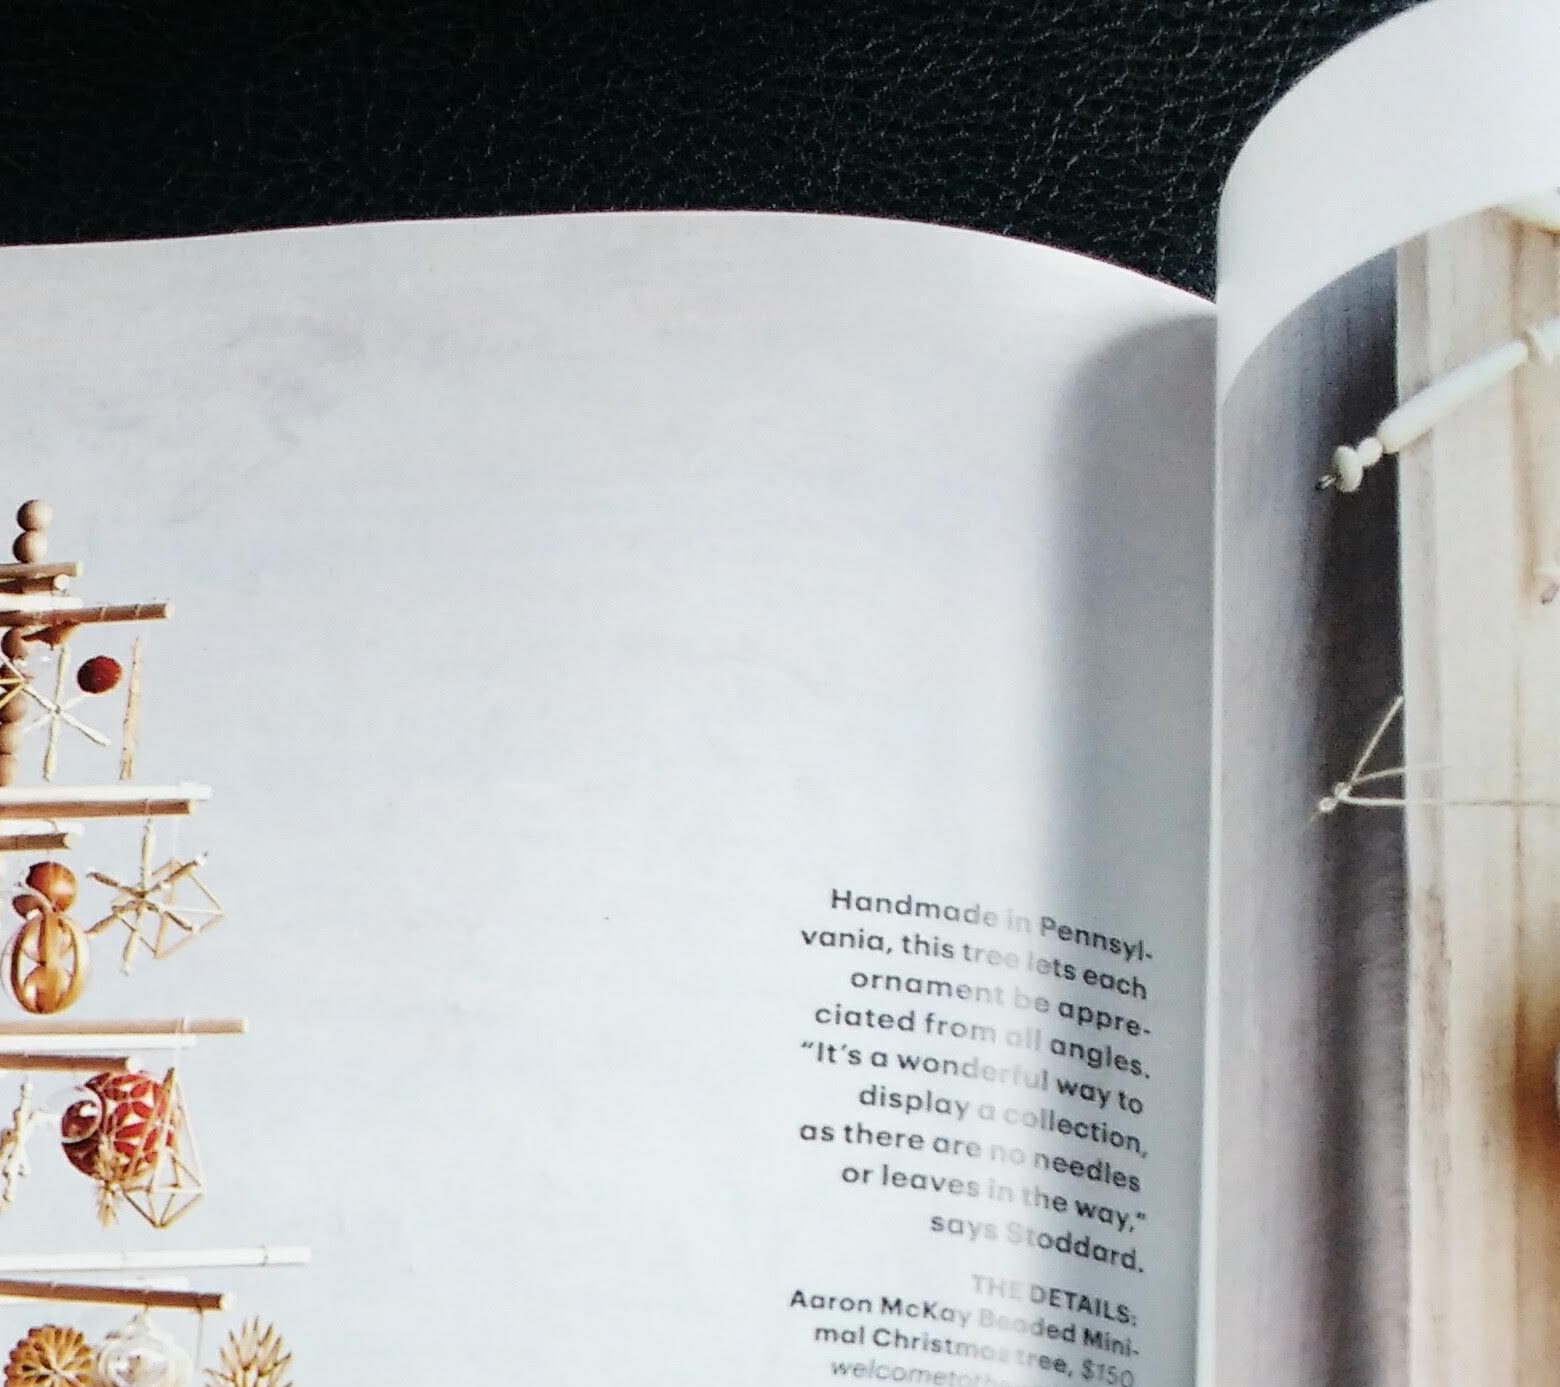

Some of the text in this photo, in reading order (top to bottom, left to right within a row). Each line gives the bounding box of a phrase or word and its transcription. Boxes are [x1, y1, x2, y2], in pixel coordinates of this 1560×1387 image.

[831, 888, 1154, 961] Handmade Pennsyl-
[801, 929, 1147, 999] vania, this tree lets each
[851, 970, 1151, 1041] ornament be appre-
[815, 1003, 1151, 1080] ciated from angles.
[871, 1050, 888, 1069] a
[898, 1054, 1049, 1091] wonderful
[1057, 1078, 1111, 1110] way
[1119, 1091, 1144, 1116] to
[859, 1084, 1148, 1159] display collection,
[801, 1123, 1141, 1194] as there are needles
[842, 1164, 874, 1185] or
[882, 1164, 980, 1198] leaves
[1022, 1187, 1068, 1212] the
[930, 1213, 1144, 1274] says Stoddard.
[790, 1289, 1140, 1358] Aaron McKay Mini-
[815, 1325, 865, 1346] mal
